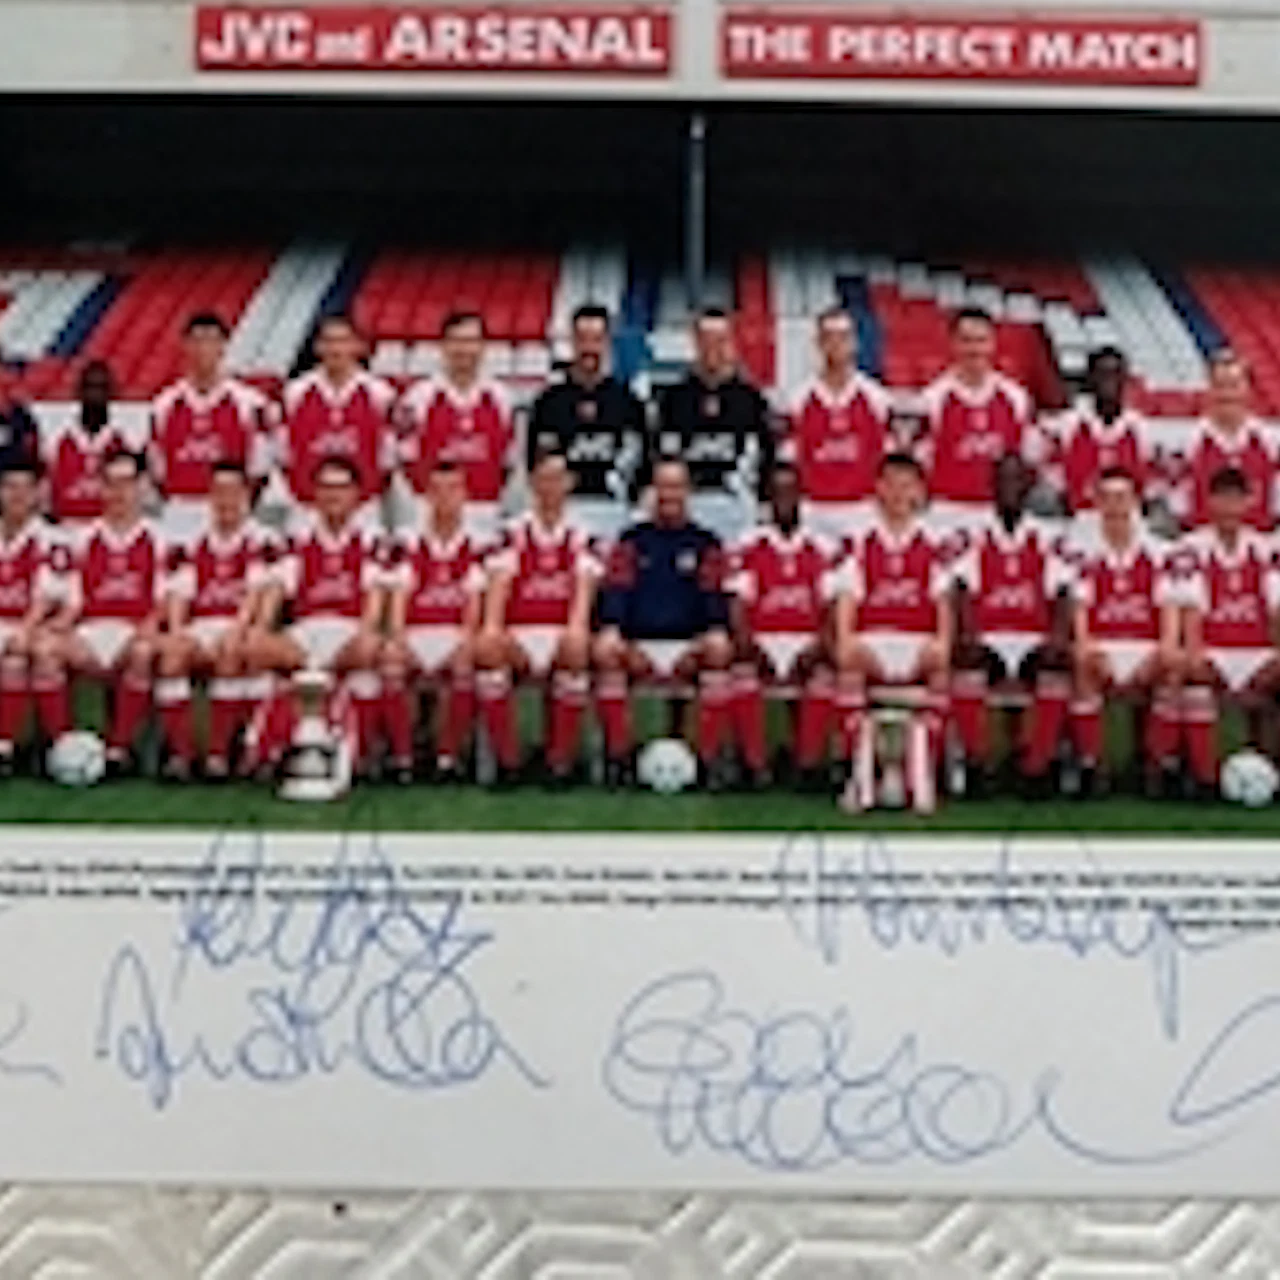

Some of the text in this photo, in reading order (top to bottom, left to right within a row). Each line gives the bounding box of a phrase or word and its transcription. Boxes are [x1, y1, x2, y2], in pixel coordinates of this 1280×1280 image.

[201, 9, 310, 62] JVC
[383, 12, 666, 64] ARSENAL
[728, 23, 1198, 71] THE PERFECT MATCH
